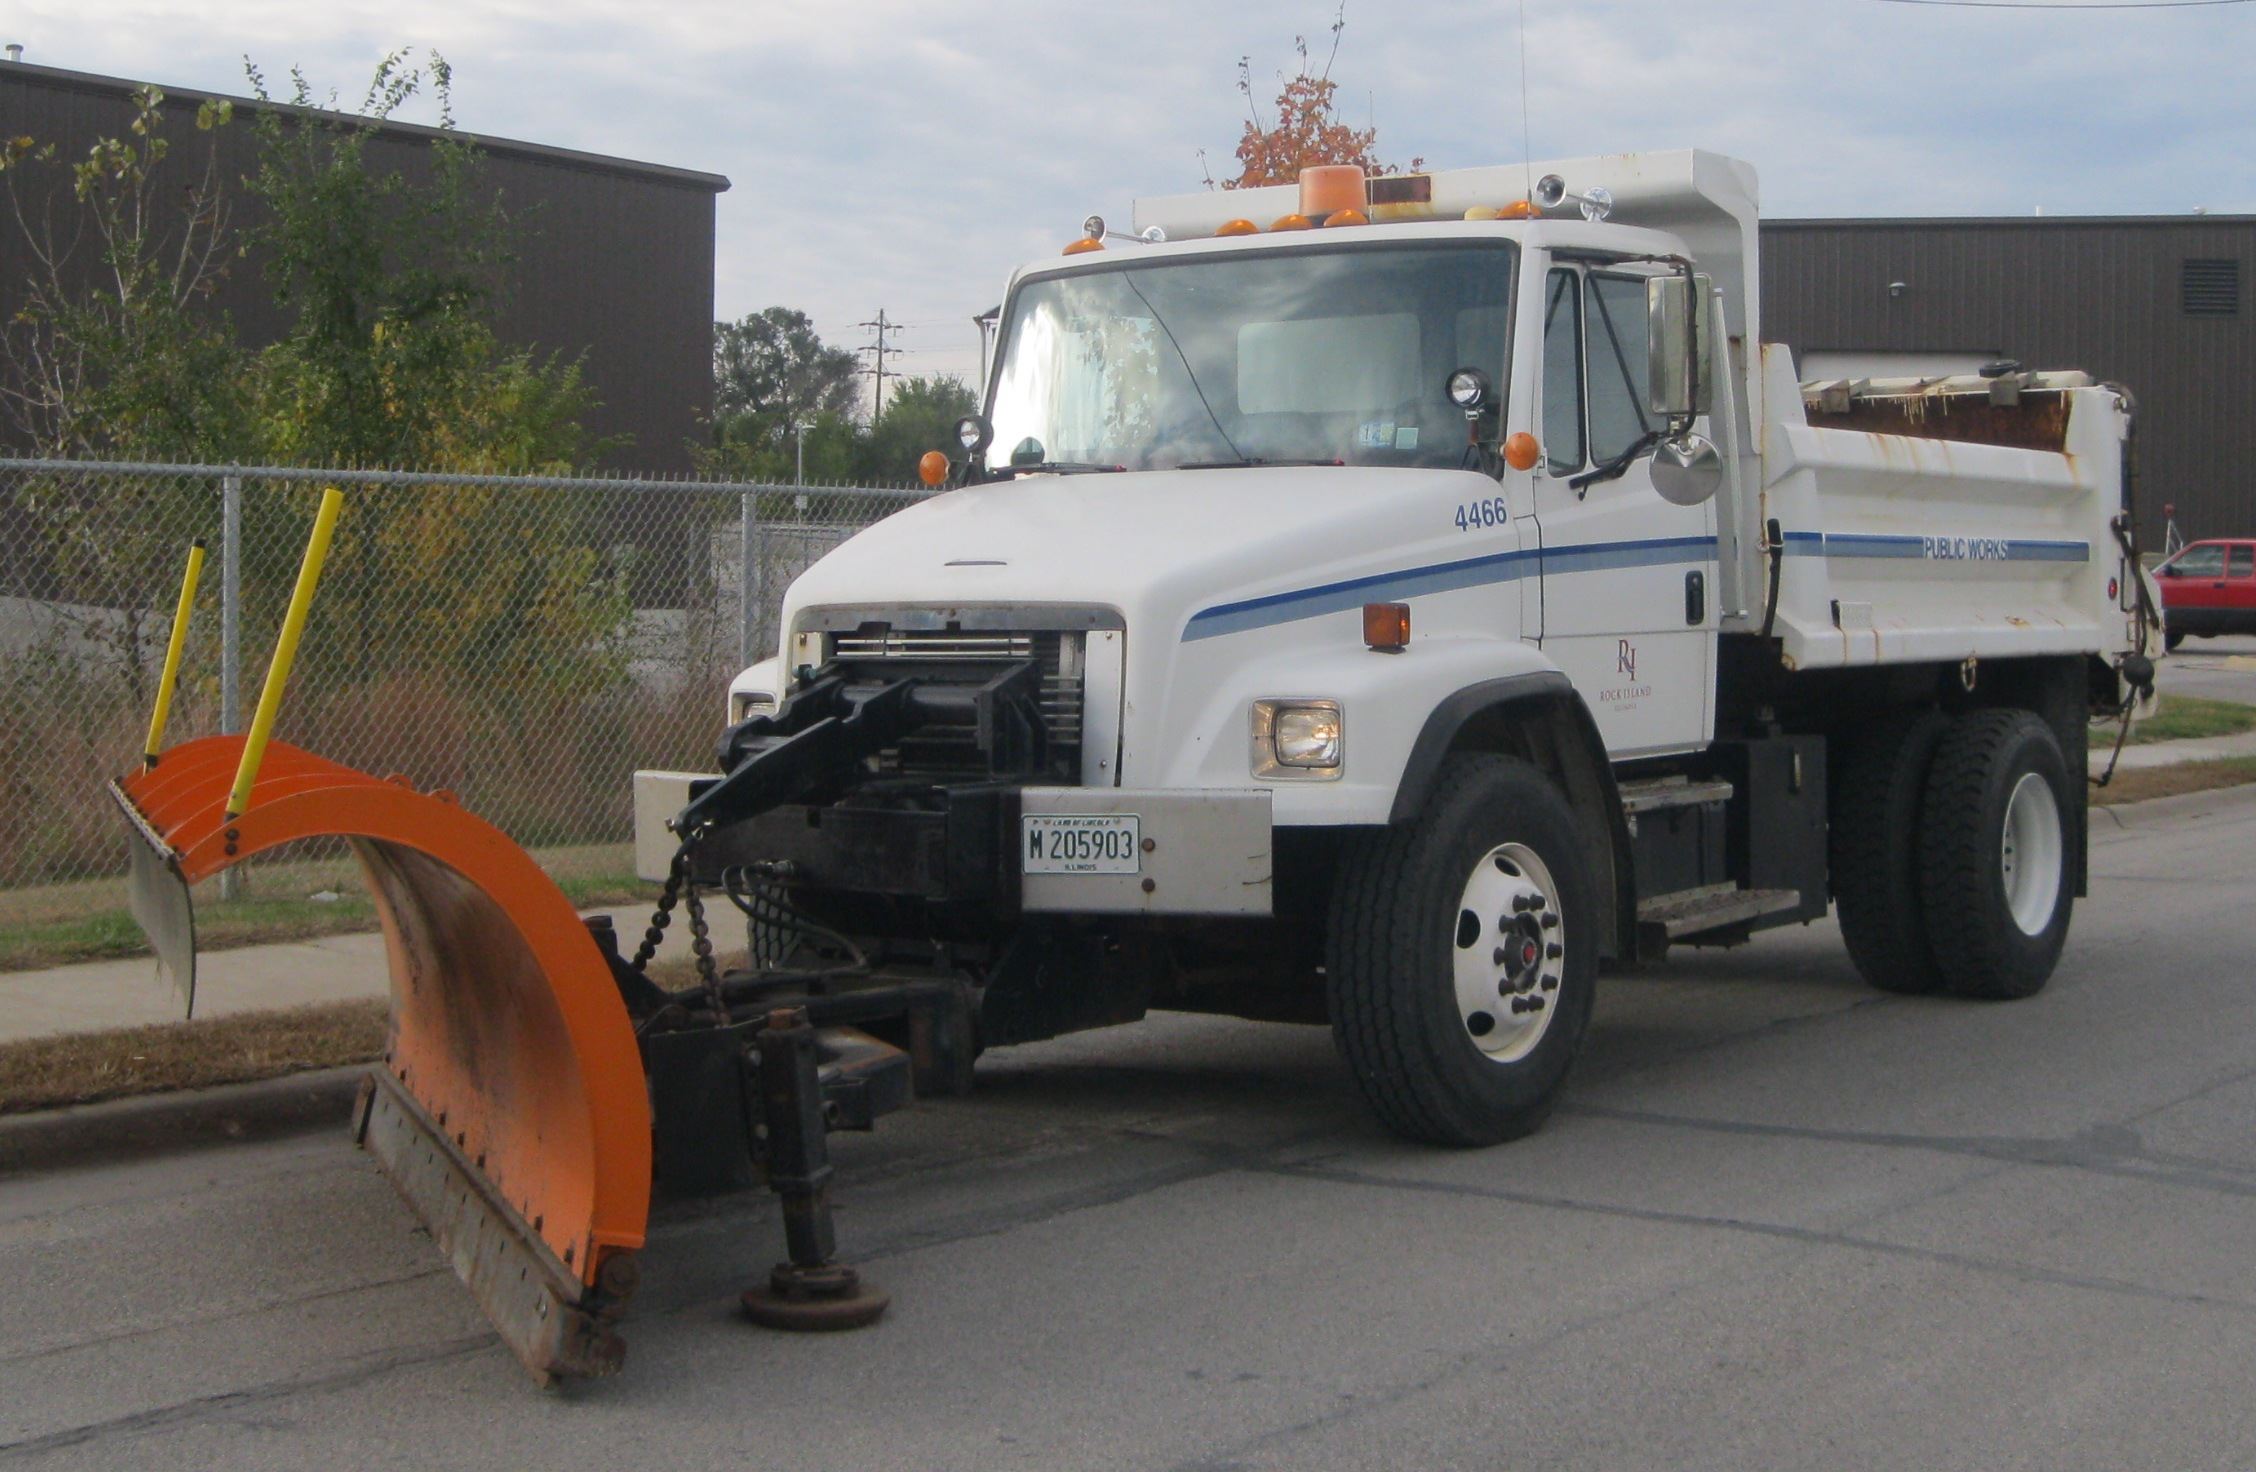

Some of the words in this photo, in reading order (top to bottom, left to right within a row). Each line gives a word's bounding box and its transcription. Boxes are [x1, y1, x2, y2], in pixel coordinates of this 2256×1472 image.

[1455, 497, 1507, 532] 4466
[1924, 537, 1965, 560] PUBLIC
[1967, 538, 2008, 560] WORKS
[1030, 830, 1042, 859] M
[1050, 830, 1133, 859] 205903
